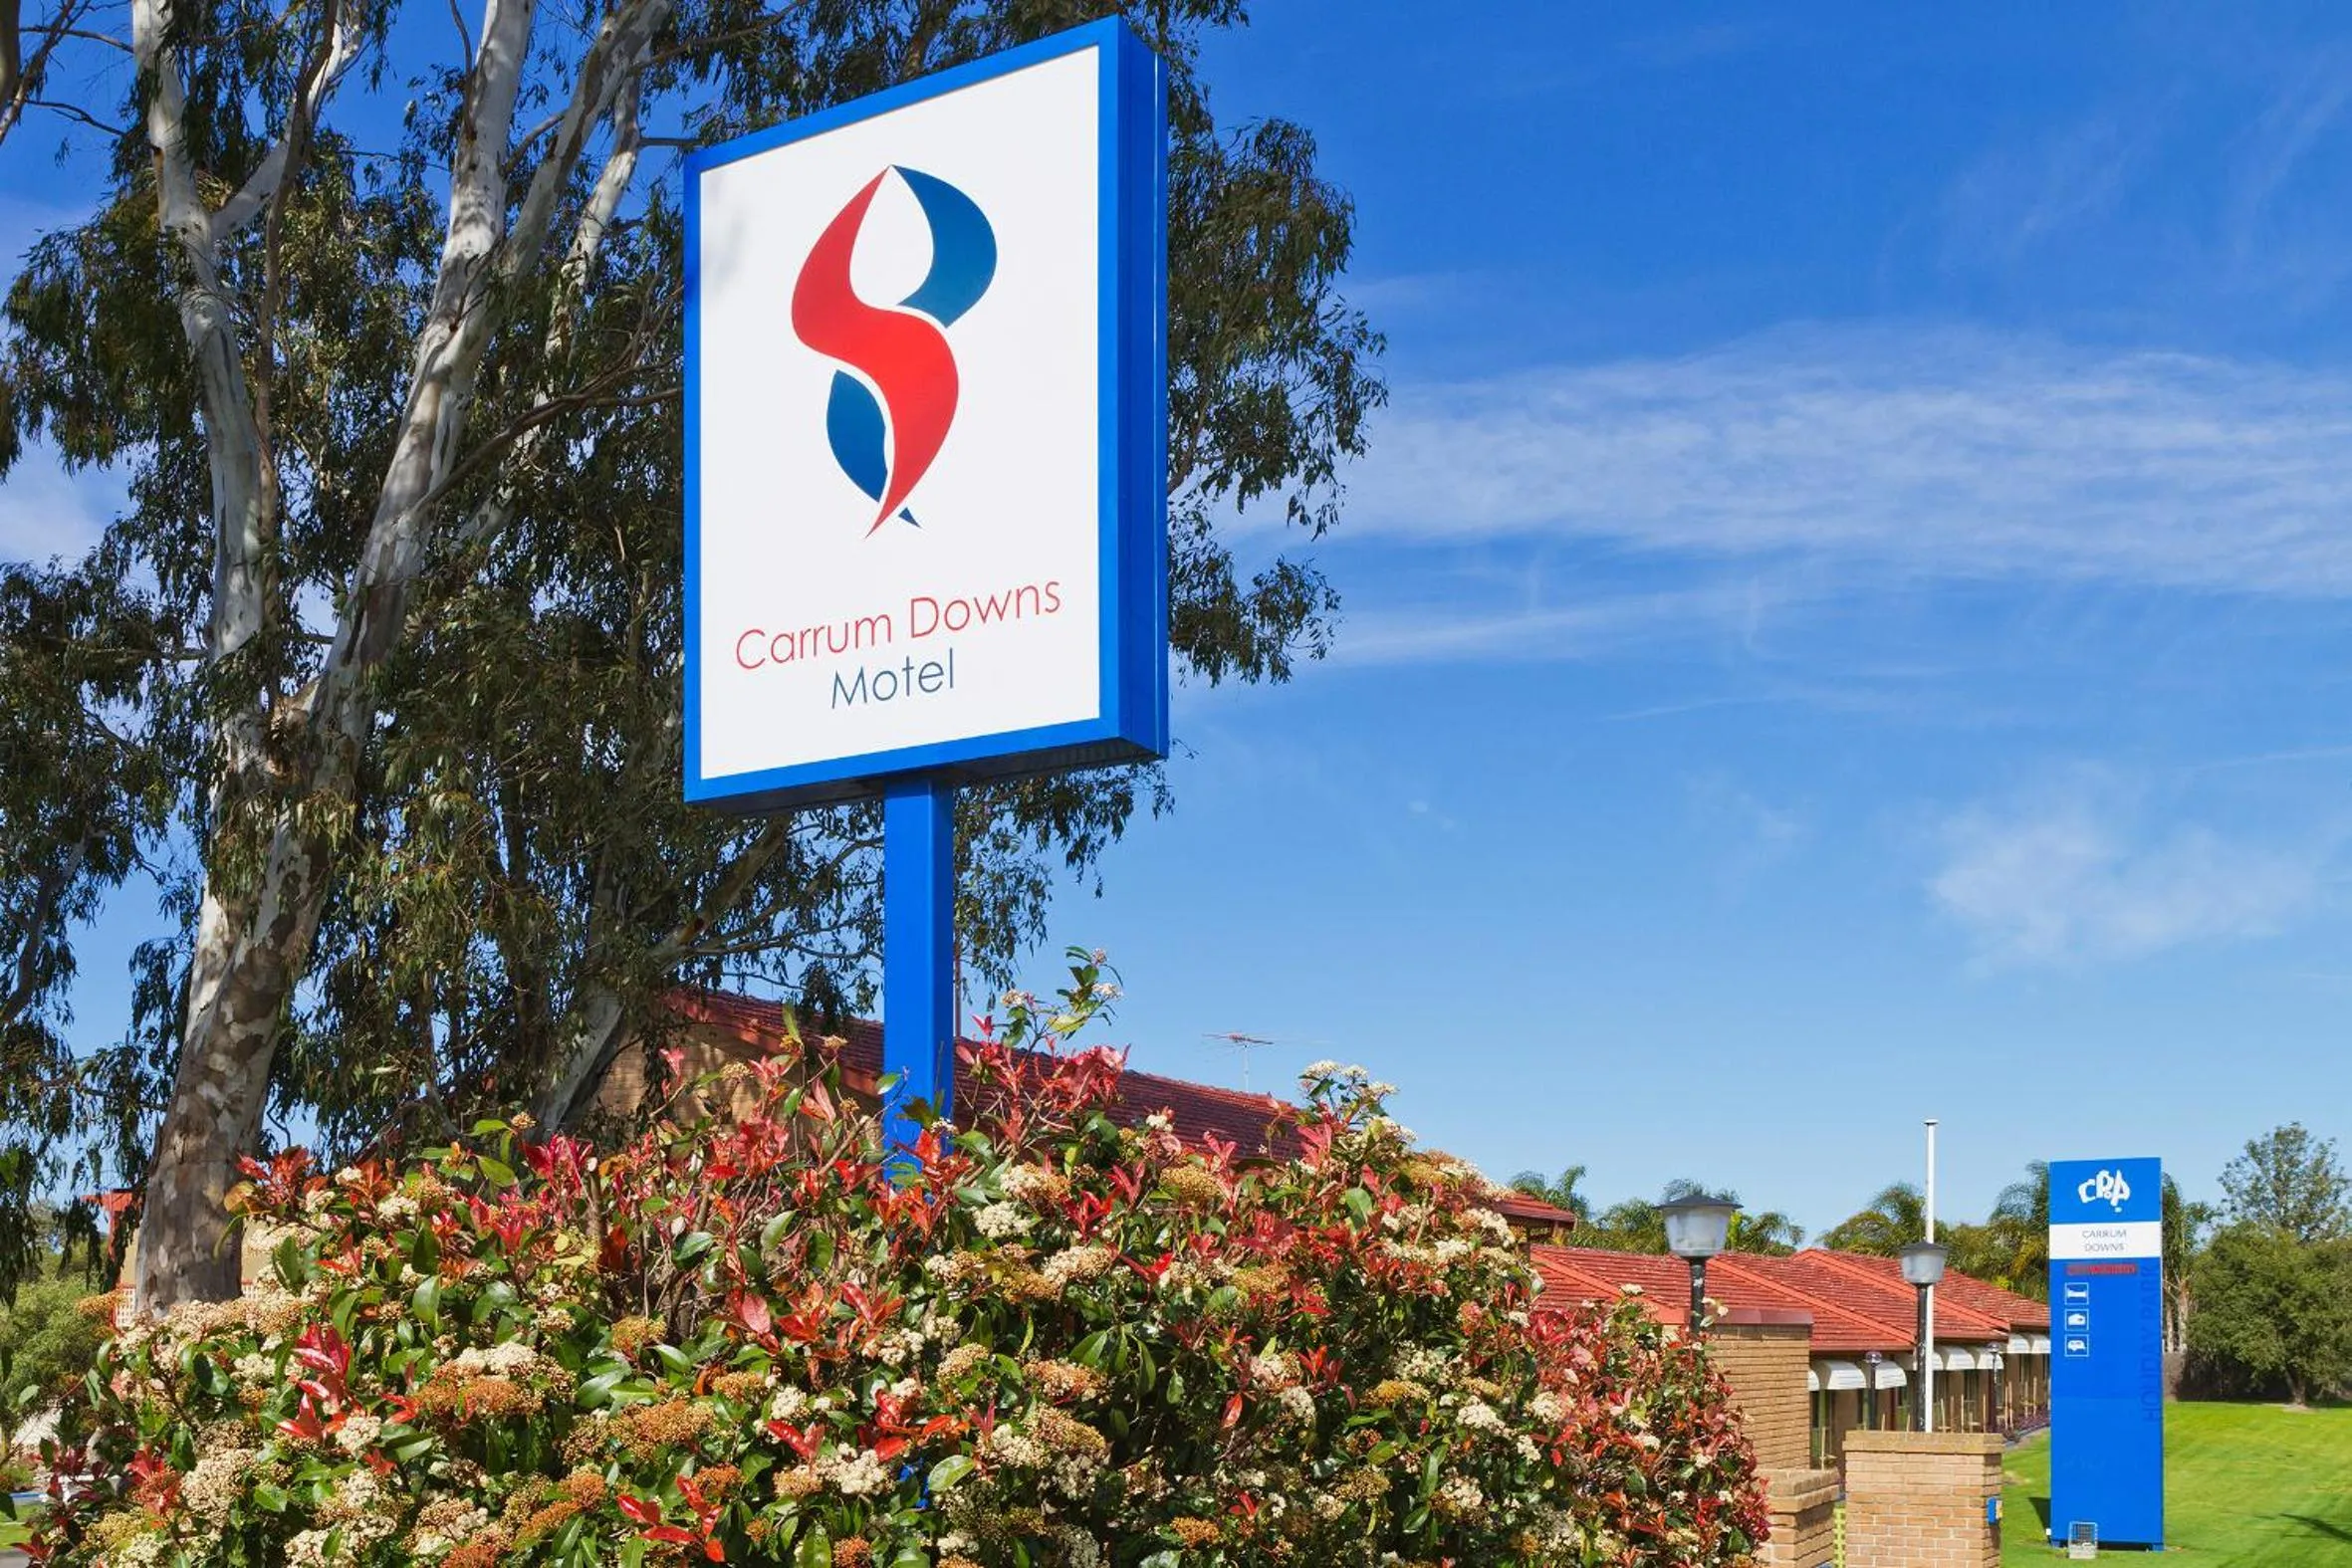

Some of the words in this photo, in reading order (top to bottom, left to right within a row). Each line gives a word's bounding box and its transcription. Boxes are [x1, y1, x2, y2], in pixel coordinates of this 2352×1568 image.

[735, 612, 893, 670] Carrum
[909, 579, 1061, 639] Downs
[830, 646, 955, 710] Motel
[2081, 1229, 2127, 1239] CARRUM
[2084, 1242, 2125, 1252] DOWNS
